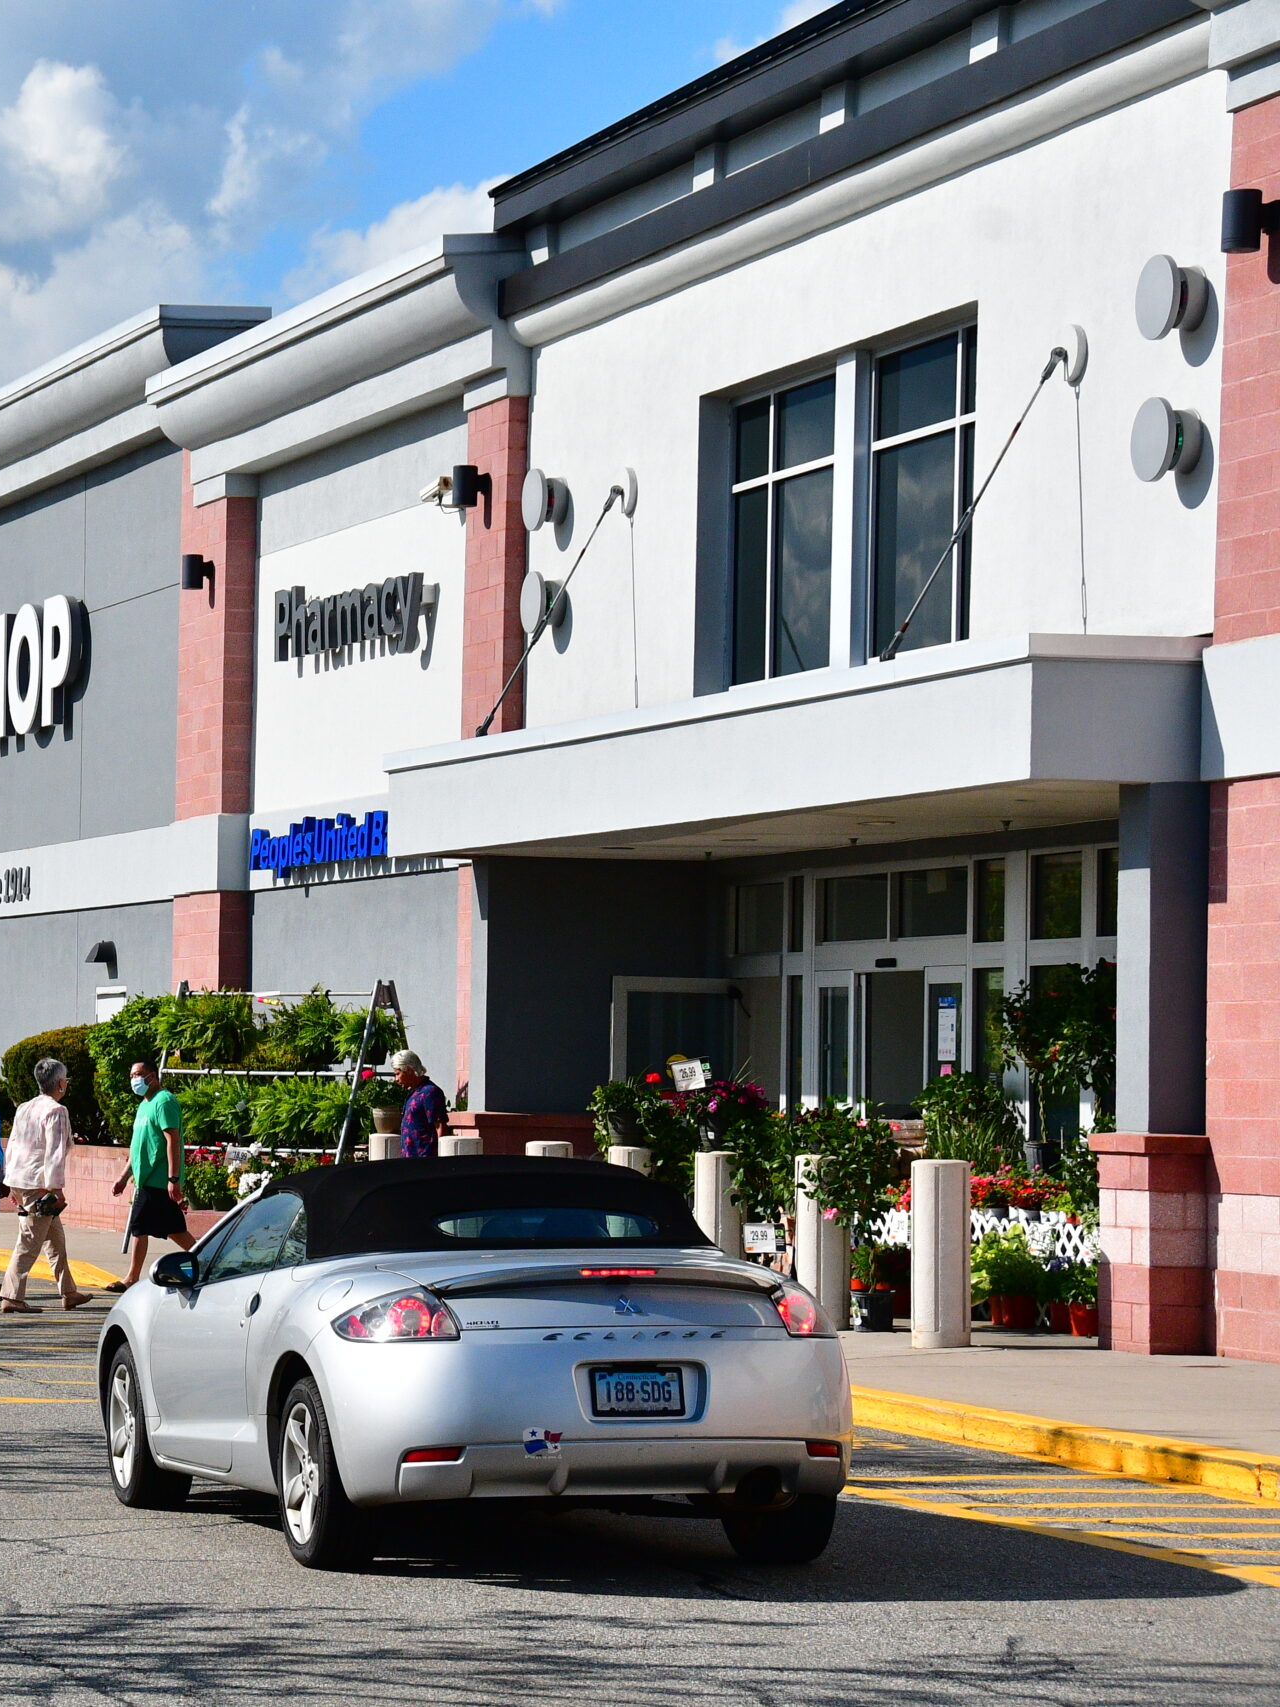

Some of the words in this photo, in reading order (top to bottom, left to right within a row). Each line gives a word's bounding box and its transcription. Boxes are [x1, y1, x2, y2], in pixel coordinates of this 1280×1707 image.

[274, 571, 425, 663] Pharmacy
[249, 816, 316, 879] People's
[313, 811, 374, 864] United
[3, 865, 31, 904] 1914
